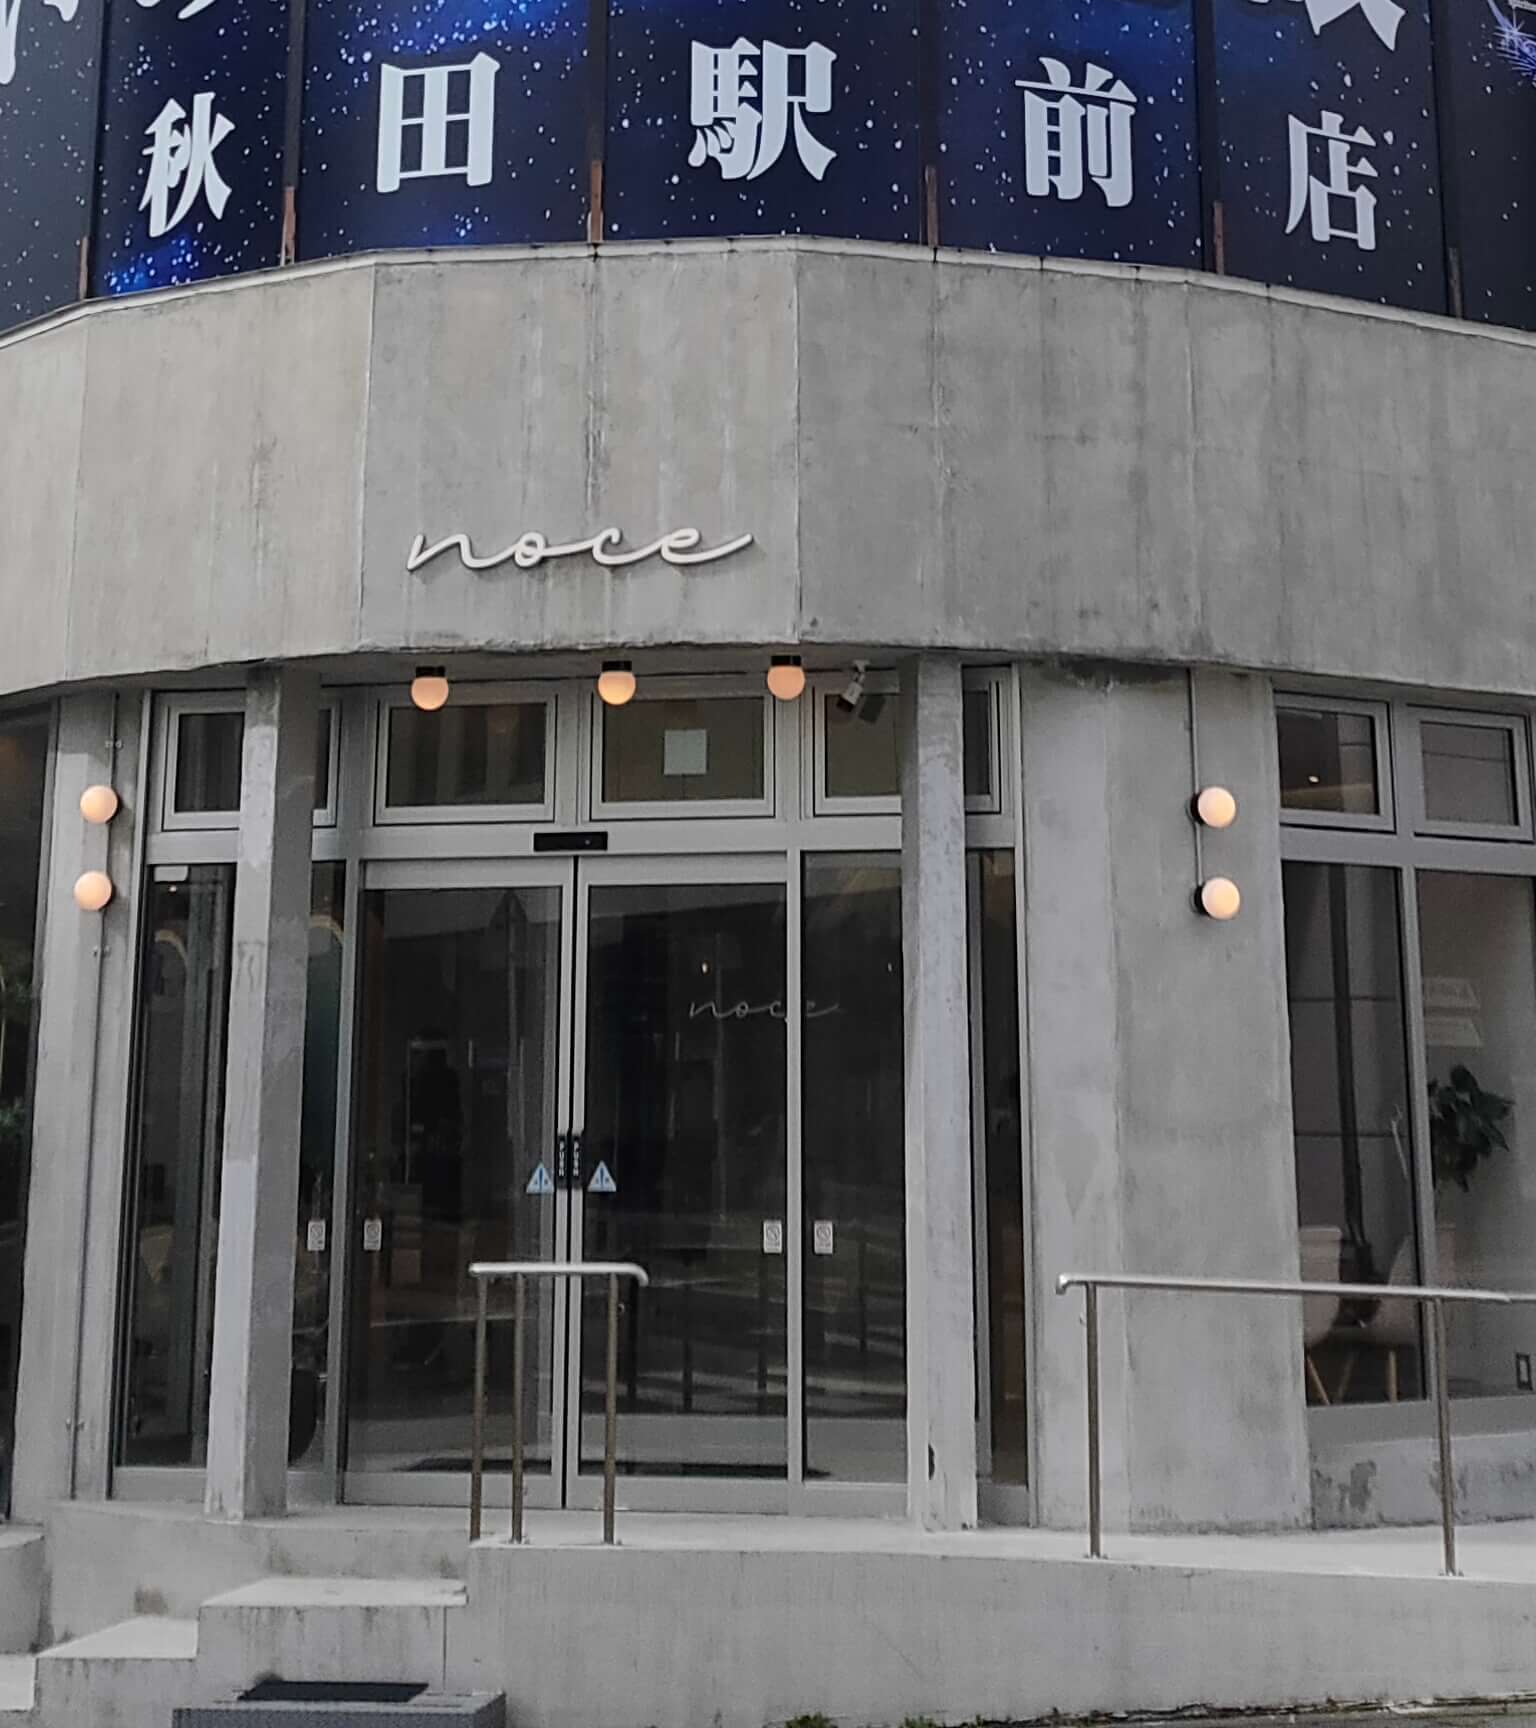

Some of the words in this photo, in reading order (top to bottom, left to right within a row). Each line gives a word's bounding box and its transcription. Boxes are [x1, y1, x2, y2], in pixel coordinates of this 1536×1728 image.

[138, 36, 1378, 251] 秋田駅前店
[407, 526, 754, 570] noce
